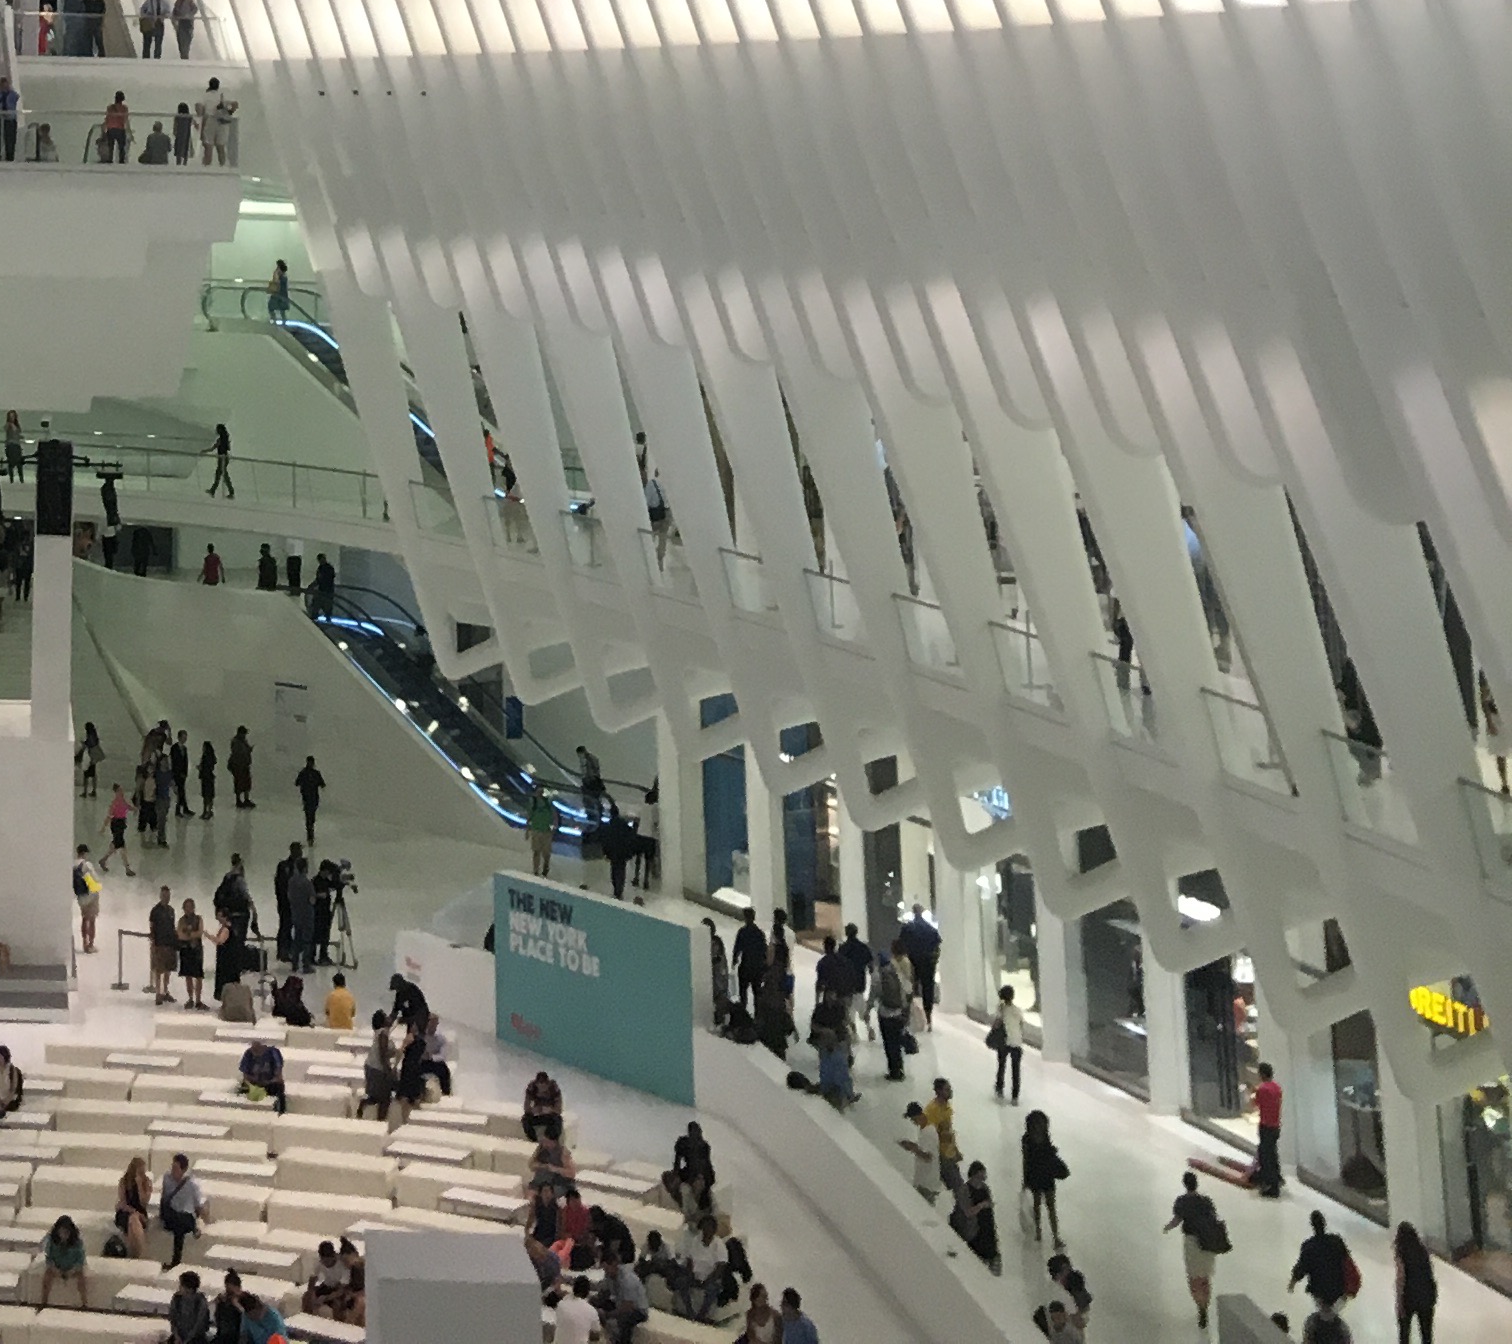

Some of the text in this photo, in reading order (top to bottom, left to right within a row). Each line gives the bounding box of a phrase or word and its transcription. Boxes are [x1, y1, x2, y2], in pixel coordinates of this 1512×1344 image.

[508, 888, 573, 925] THE NEW
[509, 910, 588, 953] NEW YORK
[509, 932, 600, 977] PLACE TO BE
